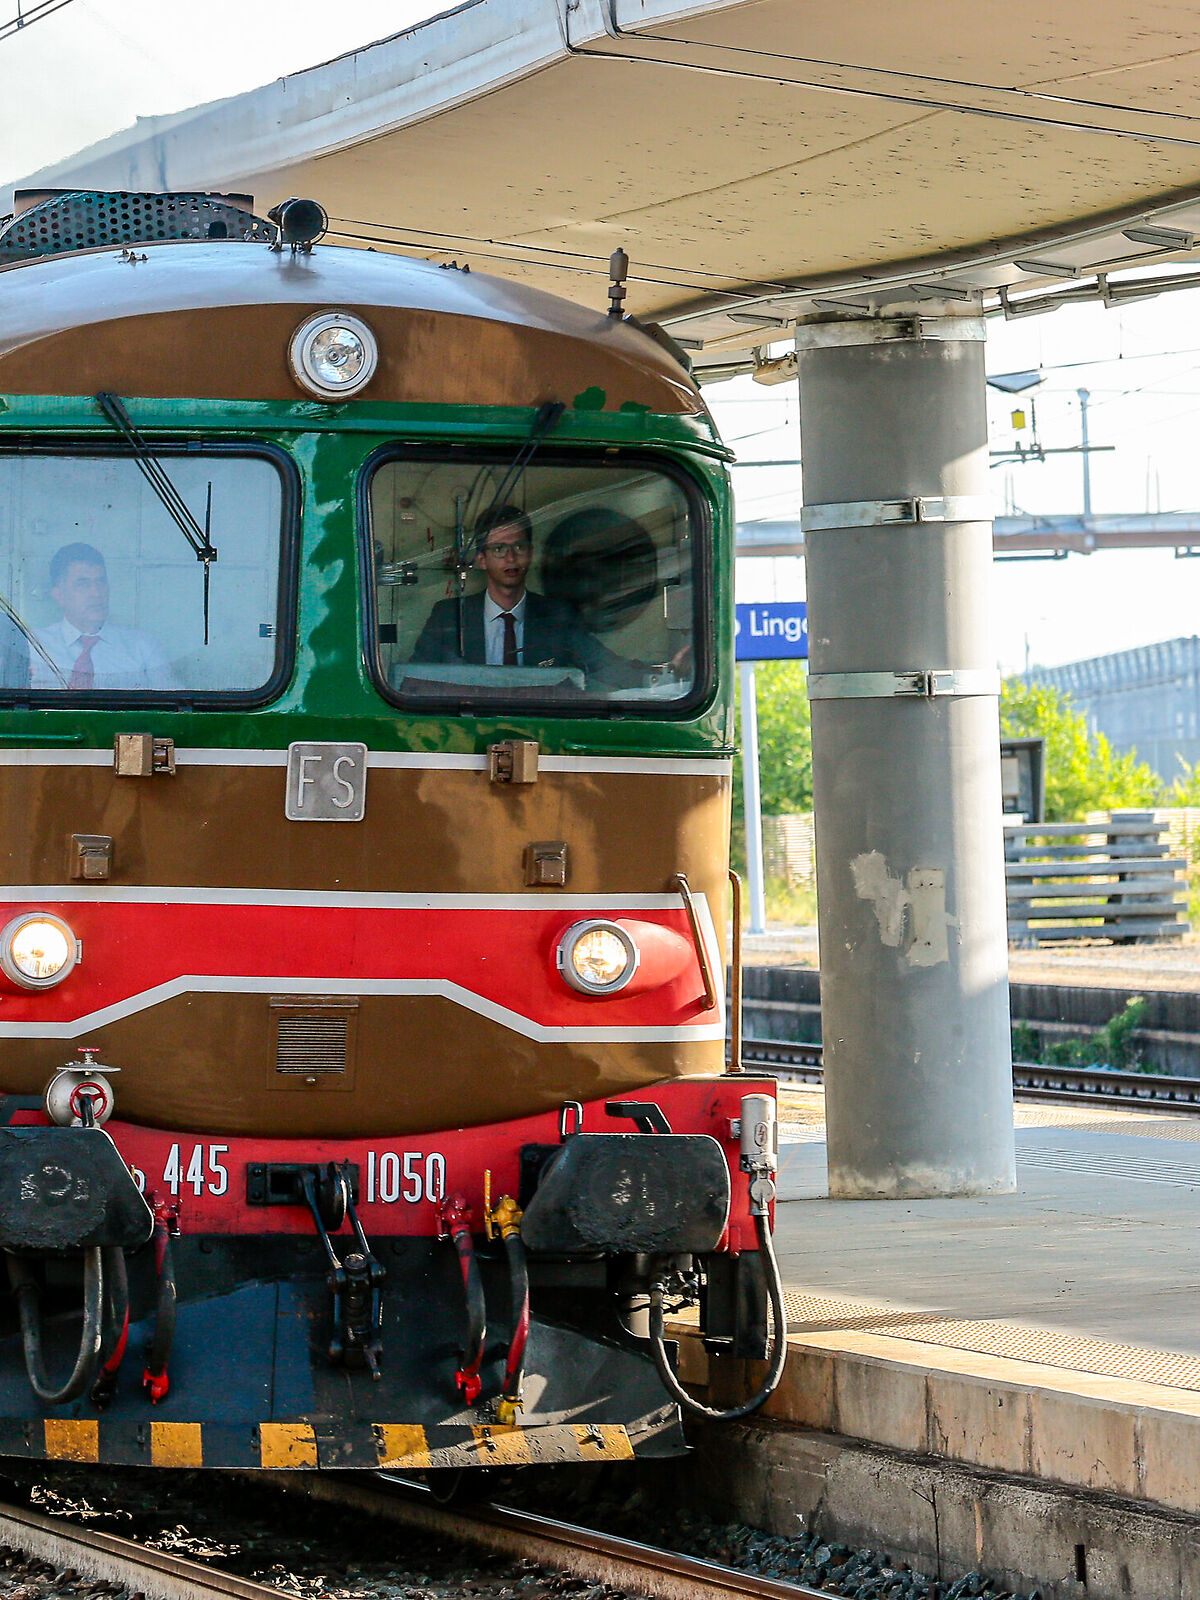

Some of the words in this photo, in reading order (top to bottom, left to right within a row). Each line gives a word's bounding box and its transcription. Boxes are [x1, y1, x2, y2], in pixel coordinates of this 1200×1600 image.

[297, 755, 356, 808] FS
[163, 1143, 229, 1196] 445
[367, 1151, 446, 1204] 1050
